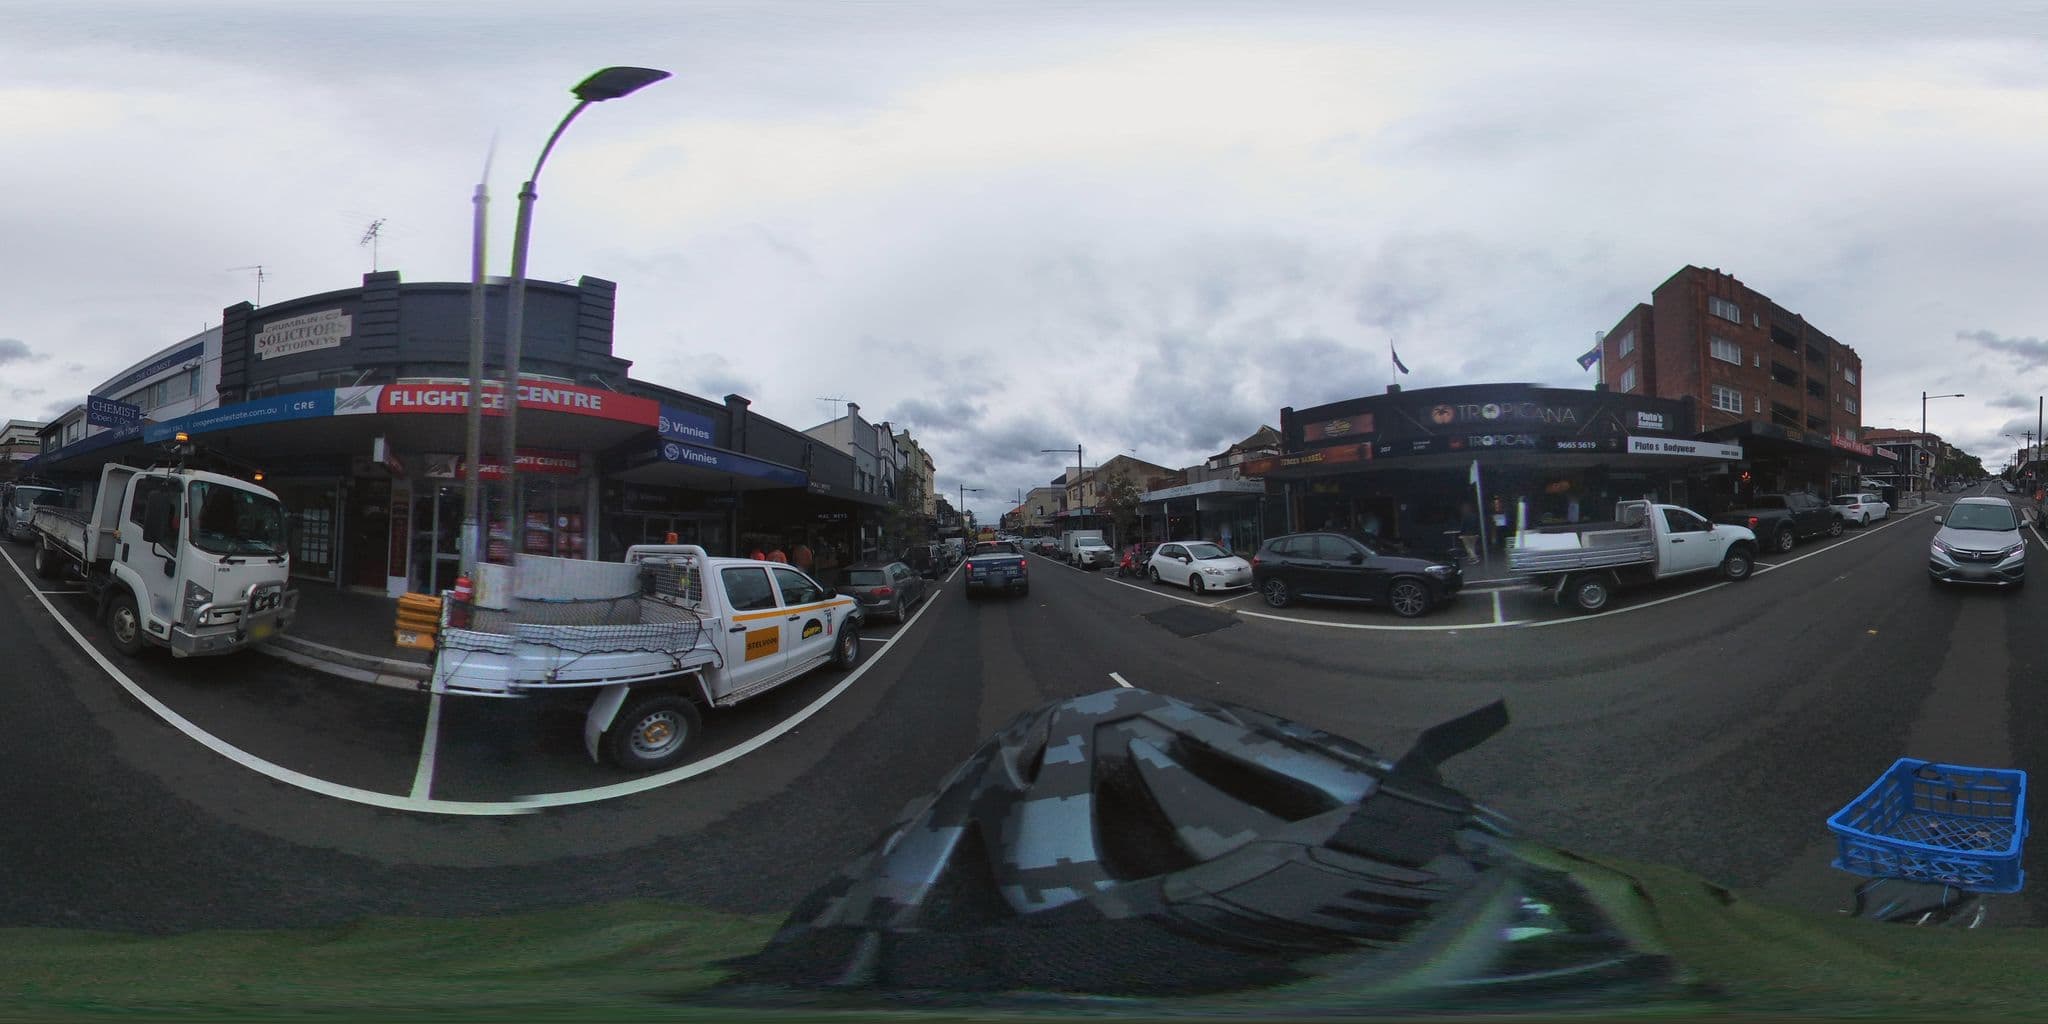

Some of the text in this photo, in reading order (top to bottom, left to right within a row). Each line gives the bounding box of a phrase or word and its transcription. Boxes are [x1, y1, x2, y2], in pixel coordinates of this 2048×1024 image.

[258, 321, 348, 348] SOLICITORS
[275, 336, 338, 353] ATTORNEYS
[293, 401, 315, 411] CRE
[389, 391, 471, 407] FLIGHT
[515, 385, 602, 411] CENTRE
[91, 401, 137, 418] CHEMIST
[672, 421, 710, 440] Vinnies
[1558, 441, 1596, 449] 9665 5619
[1664, 443, 1696, 453] Bodywear
[682, 448, 718, 465] Vinnies
